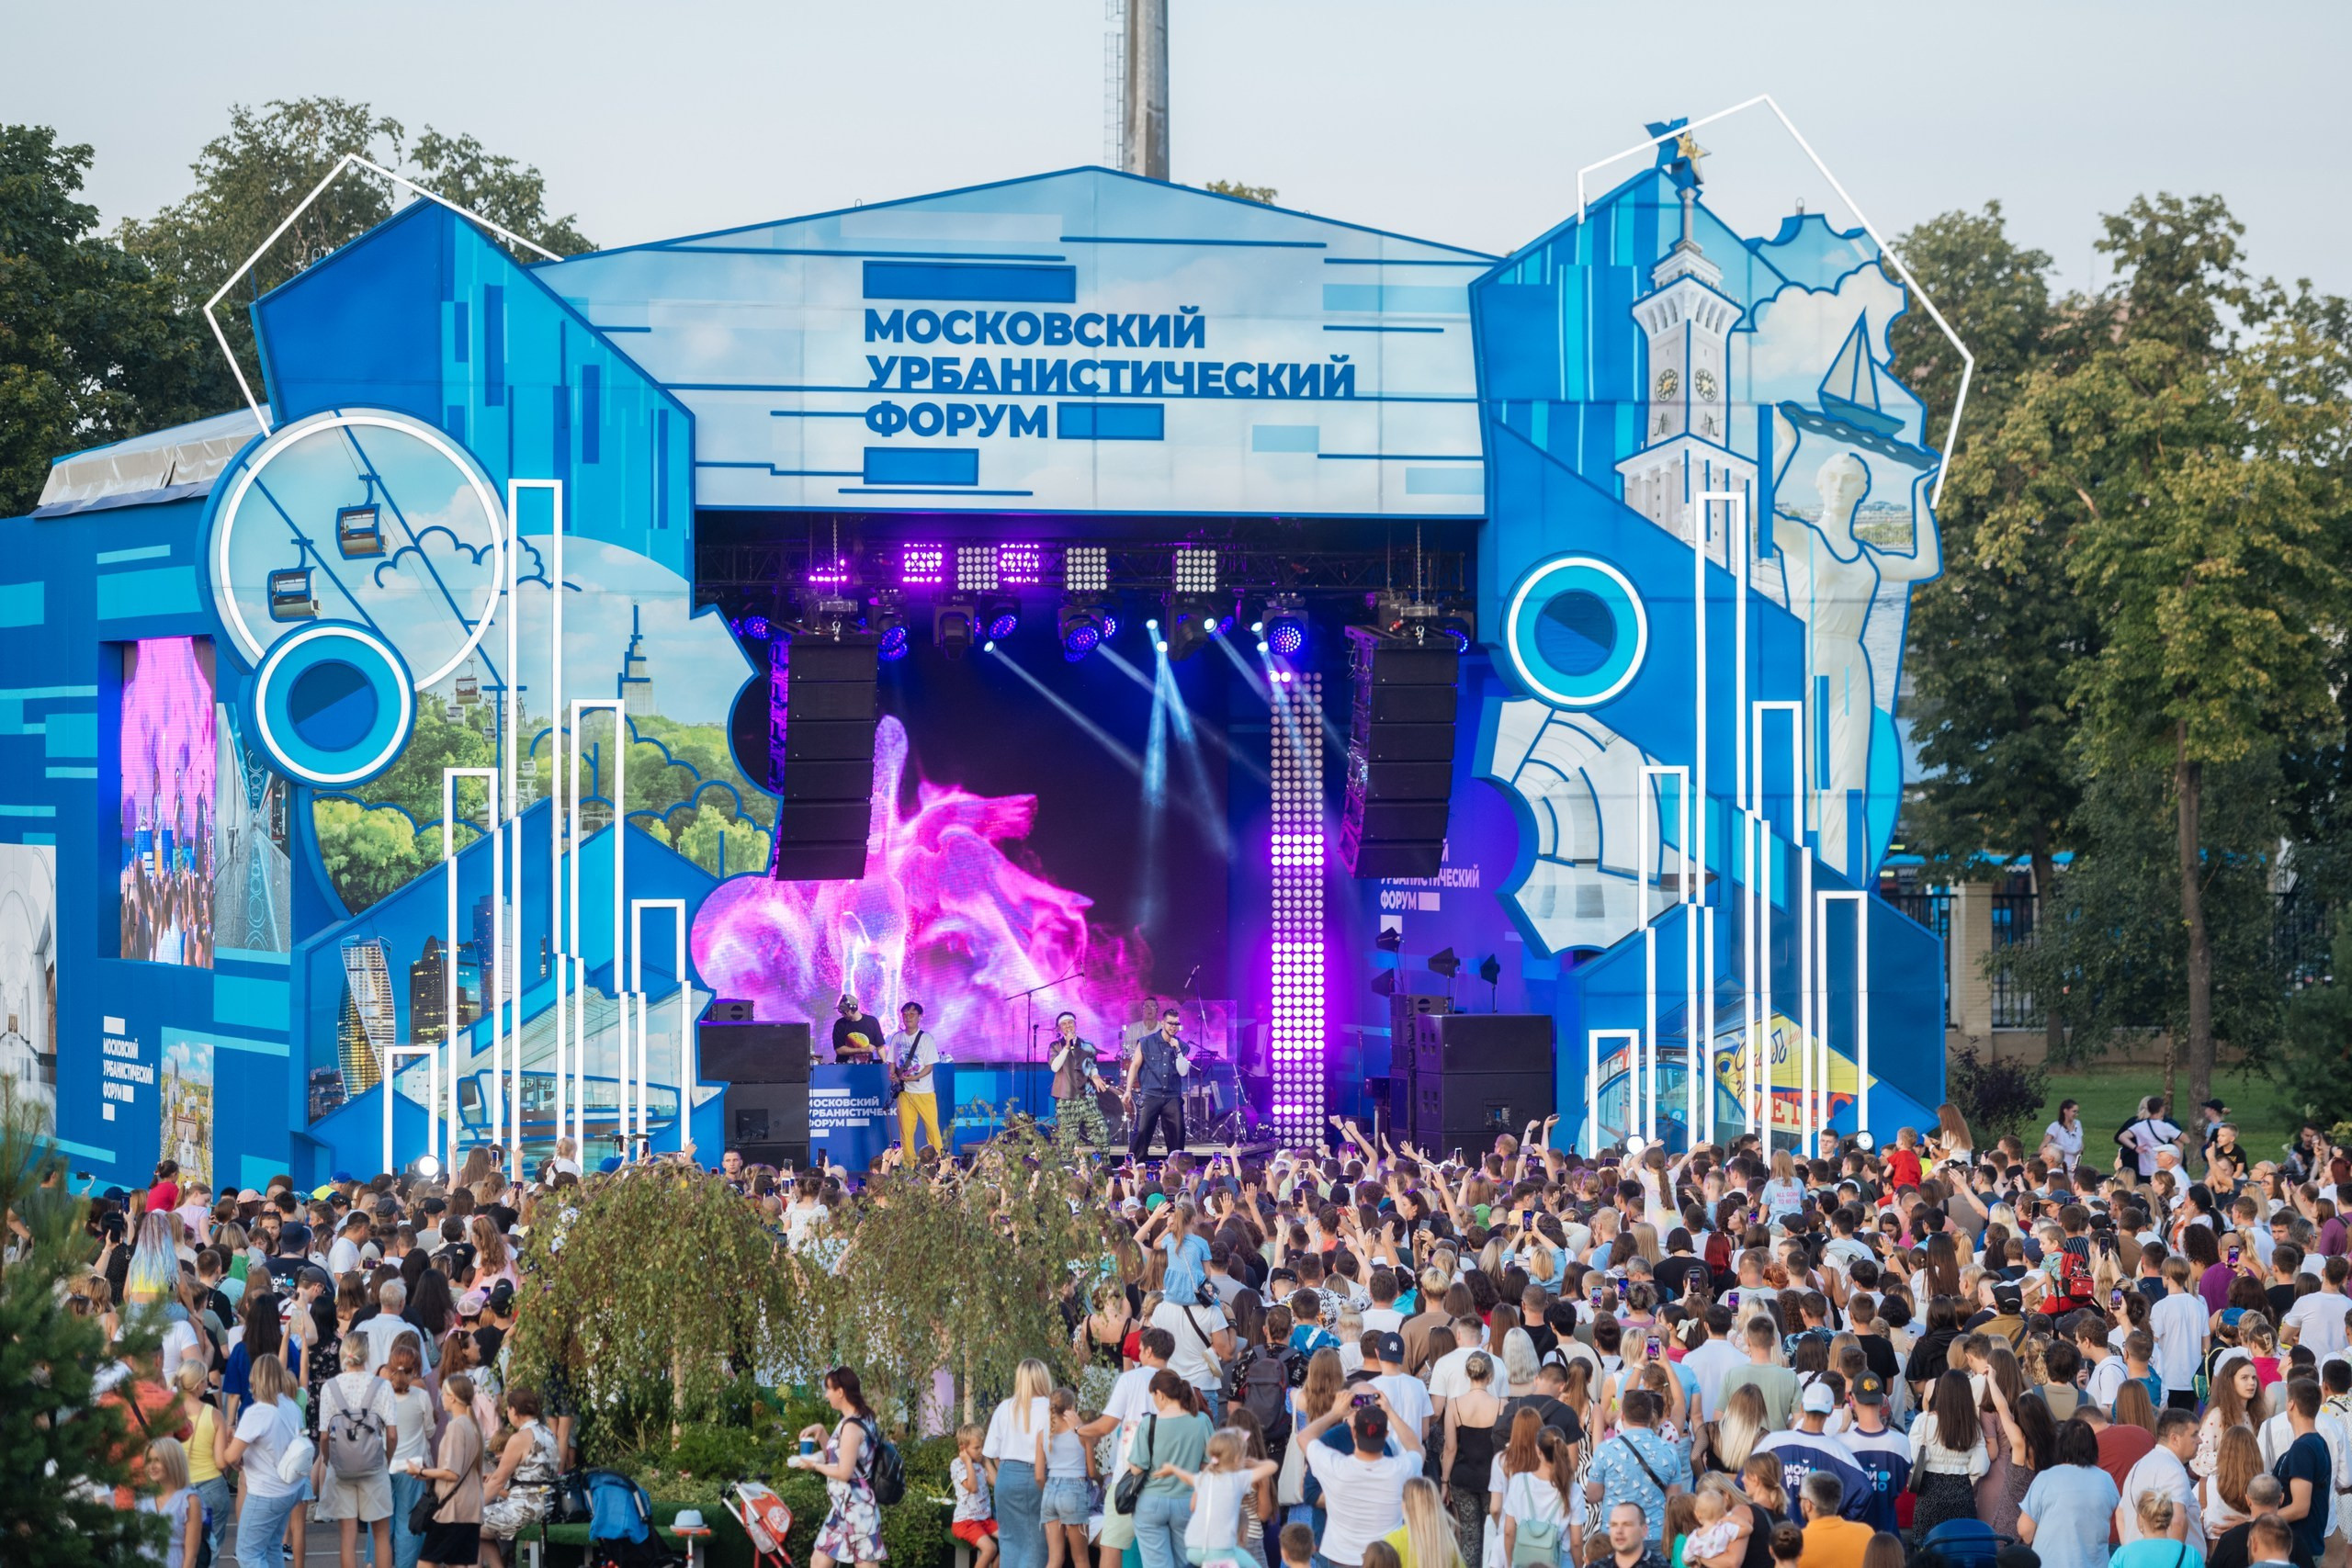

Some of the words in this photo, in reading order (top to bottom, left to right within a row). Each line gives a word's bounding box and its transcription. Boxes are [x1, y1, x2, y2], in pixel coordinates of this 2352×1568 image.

[865, 306, 1205, 349] МОСКОВСКИЙ
[865, 355, 1355, 399] УРБАНИСТИЧЕСКИЙ
[865, 400, 1048, 438] ФОРУМ
[1381, 889, 1417, 910] ФОРУМ
[103, 1038, 139, 1060] МОСКОВСКИЙ
[103, 1080, 122, 1101] ФОРУМ
